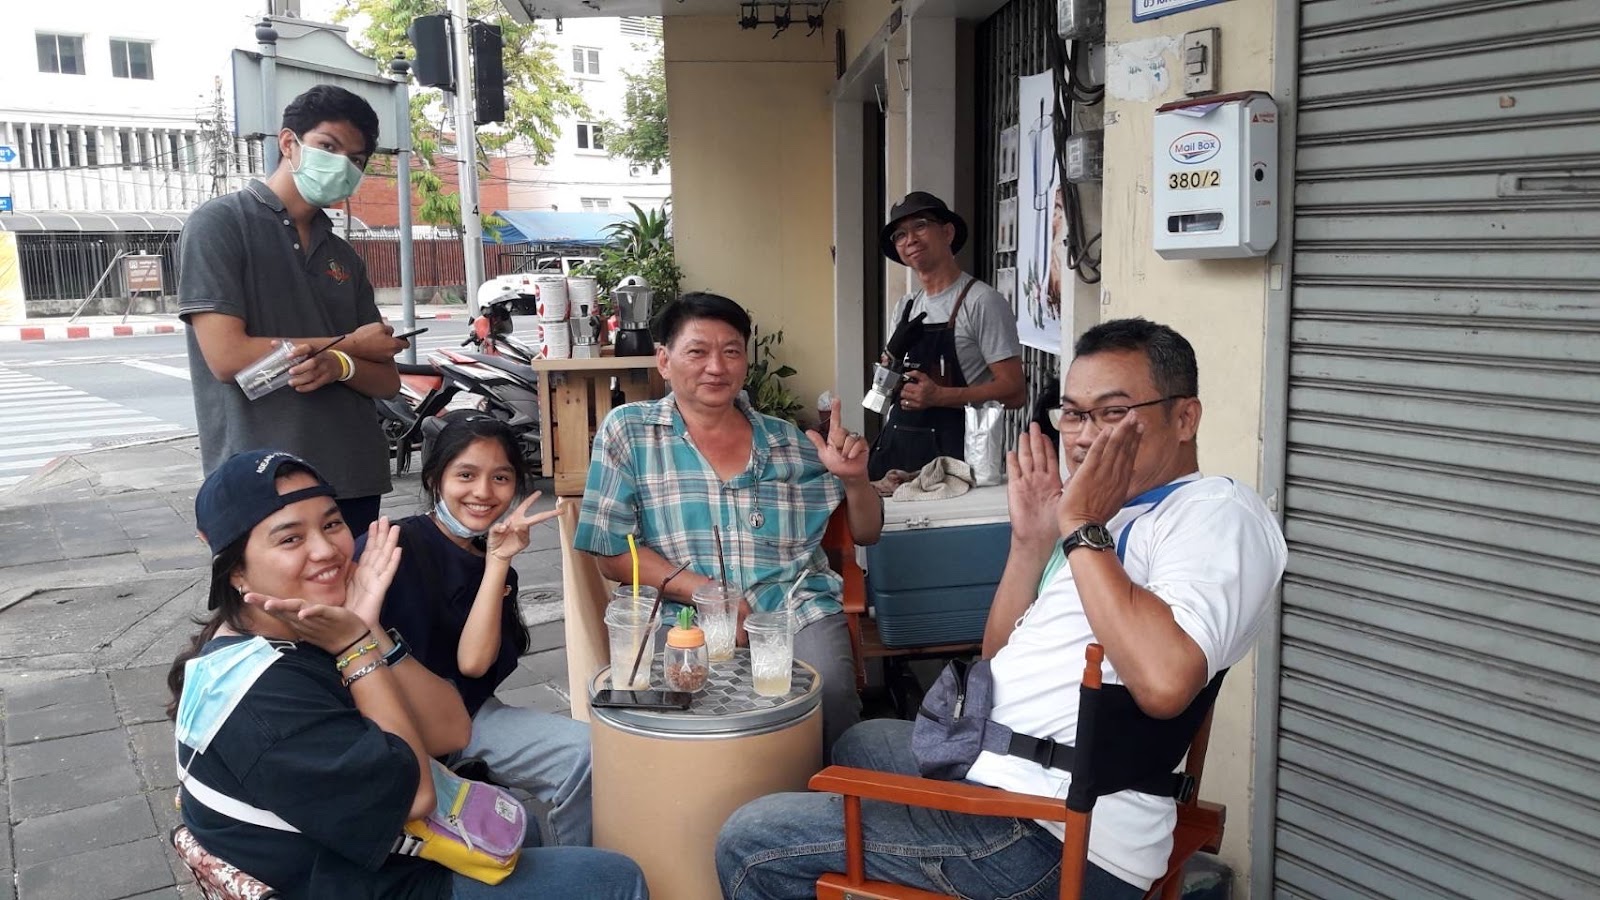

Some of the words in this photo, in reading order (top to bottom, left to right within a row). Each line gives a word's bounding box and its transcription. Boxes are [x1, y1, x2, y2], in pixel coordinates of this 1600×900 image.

[1175, 142, 1195, 153] Mail
[1198, 141, 1216, 150] Box
[1169, 170, 1219, 189] 380/2
[472, 205, 479, 216] 4
